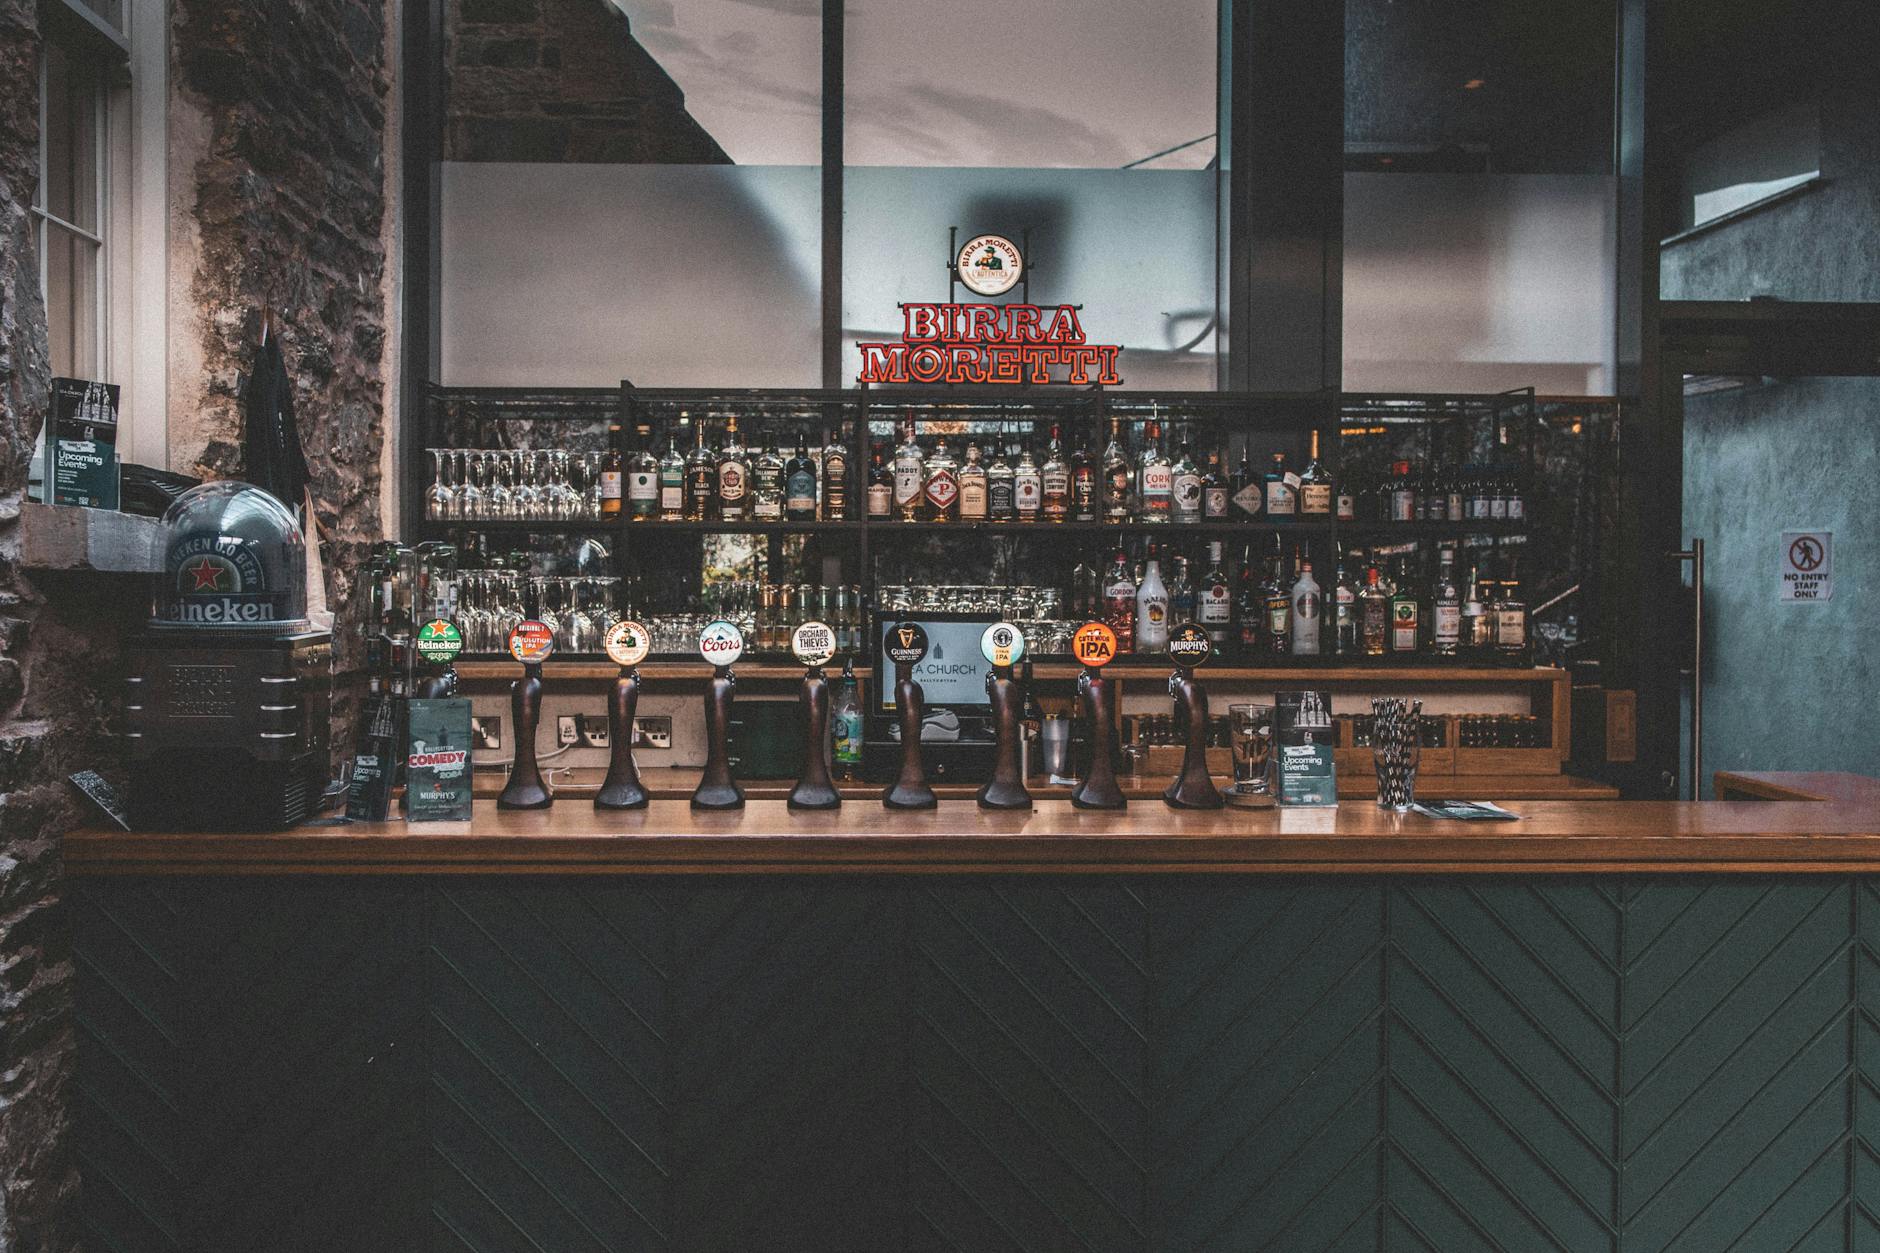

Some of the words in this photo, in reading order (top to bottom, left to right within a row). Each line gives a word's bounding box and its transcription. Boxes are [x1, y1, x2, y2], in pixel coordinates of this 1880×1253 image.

[962, 241, 984, 267] BIRRA
[985, 239, 1018, 267] MORETTI
[903, 303, 1086, 344] BIRRA
[860, 344, 1124, 385] MORETTI
[58, 450, 103, 466] Upcoming
[58, 459, 87, 470] Events
[690, 465, 714, 473] JAMESON
[1146, 474, 1170, 484] CORK
[940, 484, 949, 495] P
[236, 553, 257, 586] BEER
[1794, 582, 1819, 590] STAFF
[161, 598, 275, 622] eineken
[608, 625, 622, 645] BIRRA
[623, 623, 647, 645] MORETTI
[799, 629, 828, 638] ORCHARD
[417, 640, 462, 650] Heineken
[702, 639, 740, 652] Coors
[799, 638, 829, 648] THIEVES
[1170, 640, 1209, 653] MURPHY'S
[1081, 642, 1111, 657] IPA
[927, 664, 976, 675] CHURCH
[409, 752, 465, 766] COMEDY
[1284, 756, 1322, 766] Upcoming
[420, 791, 455, 800] MURPHY'S
